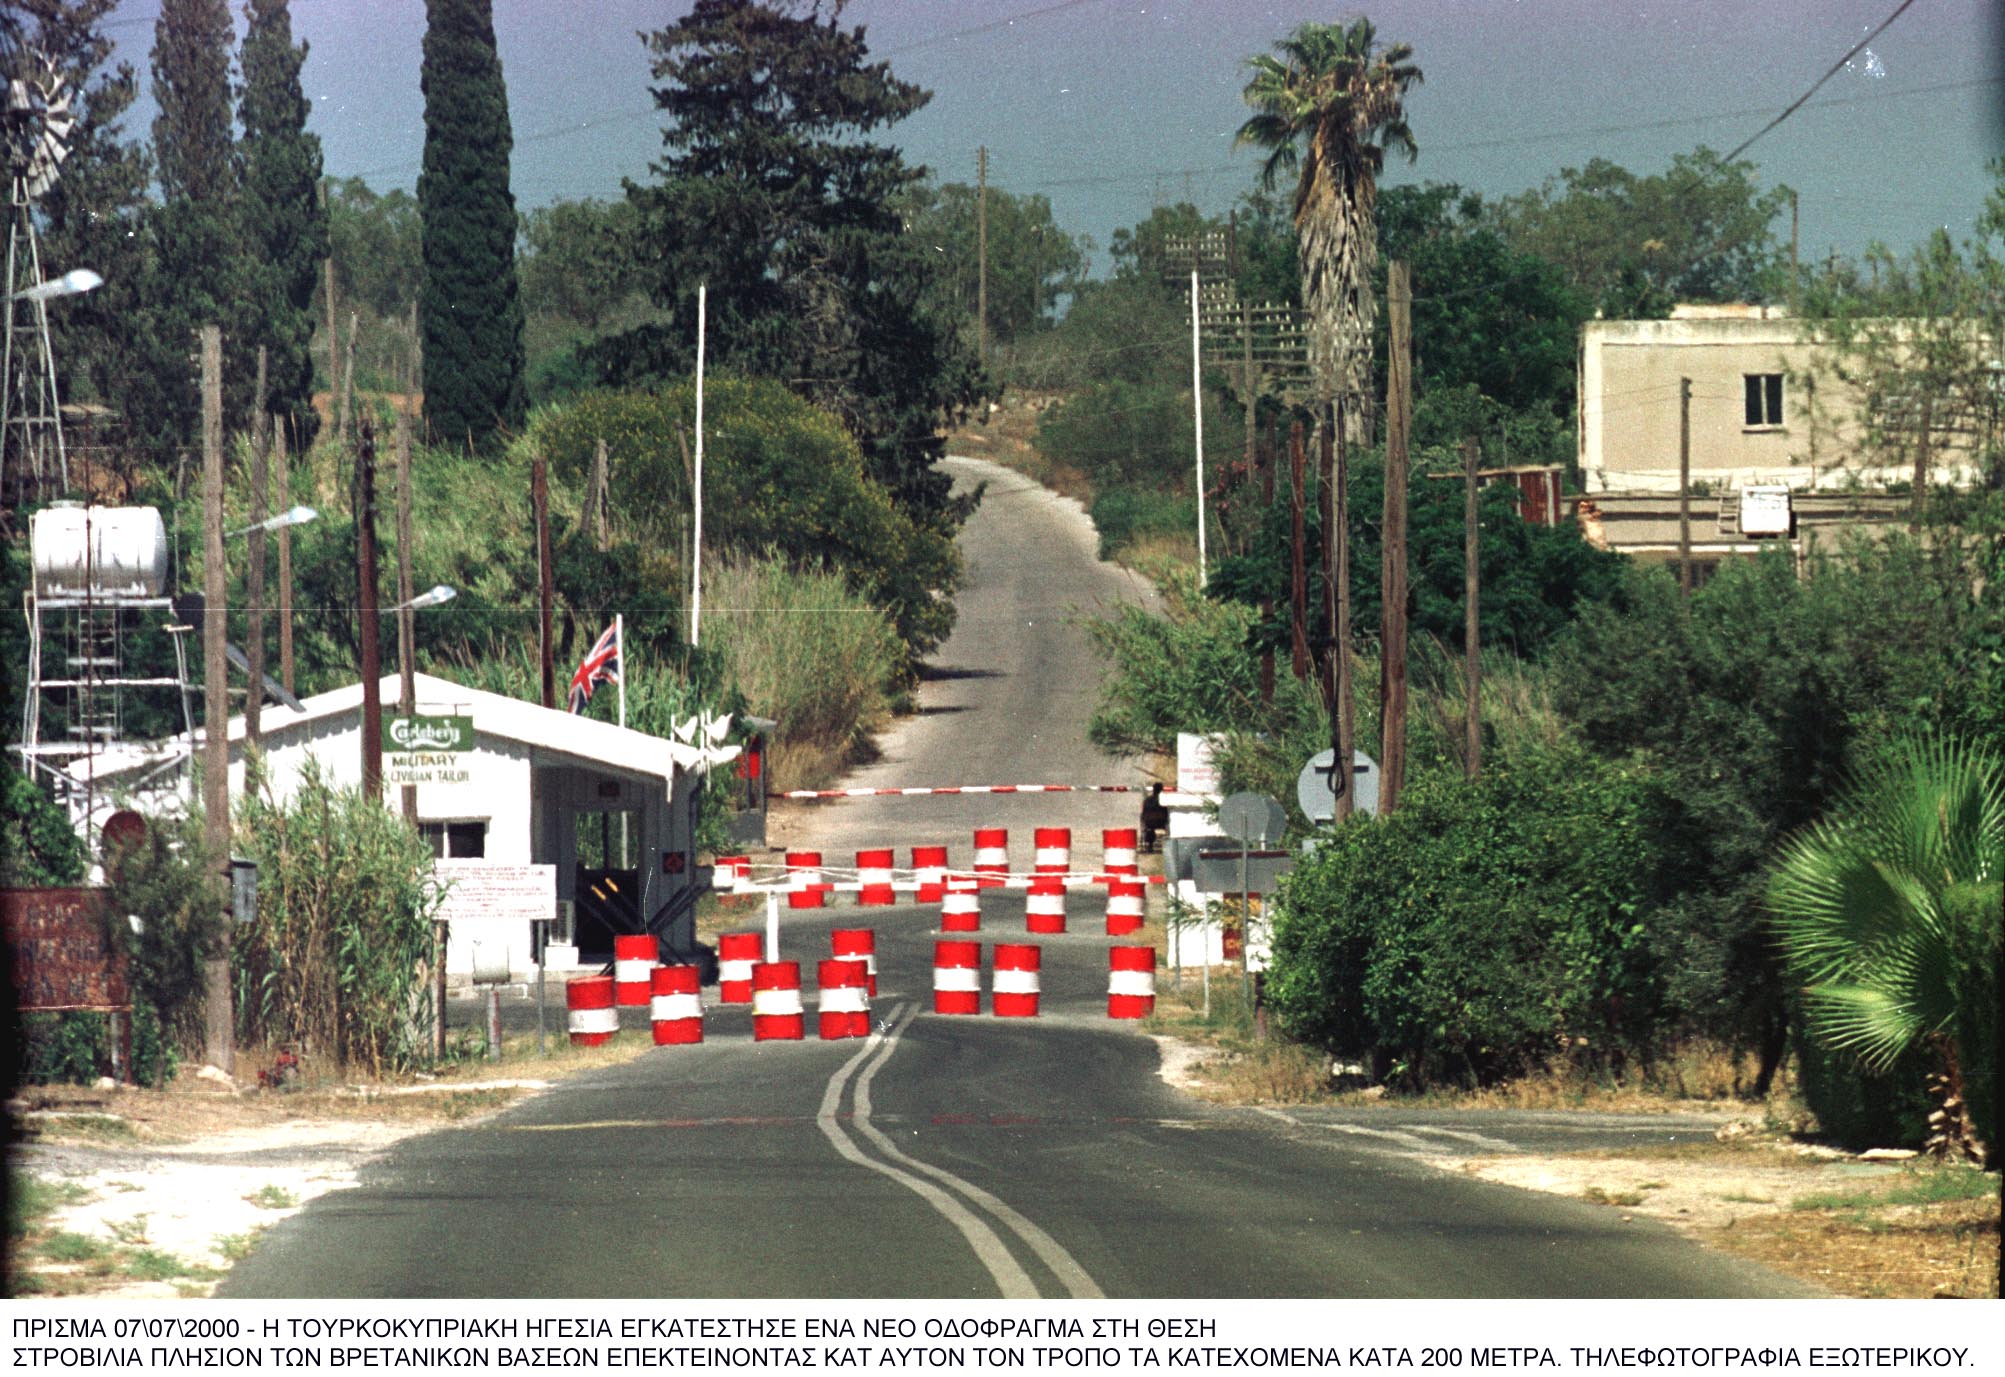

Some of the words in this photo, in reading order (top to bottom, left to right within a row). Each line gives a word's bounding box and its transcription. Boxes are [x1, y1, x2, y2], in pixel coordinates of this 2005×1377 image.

[390, 718, 461, 748] Carlsberg
[392, 754, 457, 767] MILITARY
[437, 770, 469, 783] TAILOR
